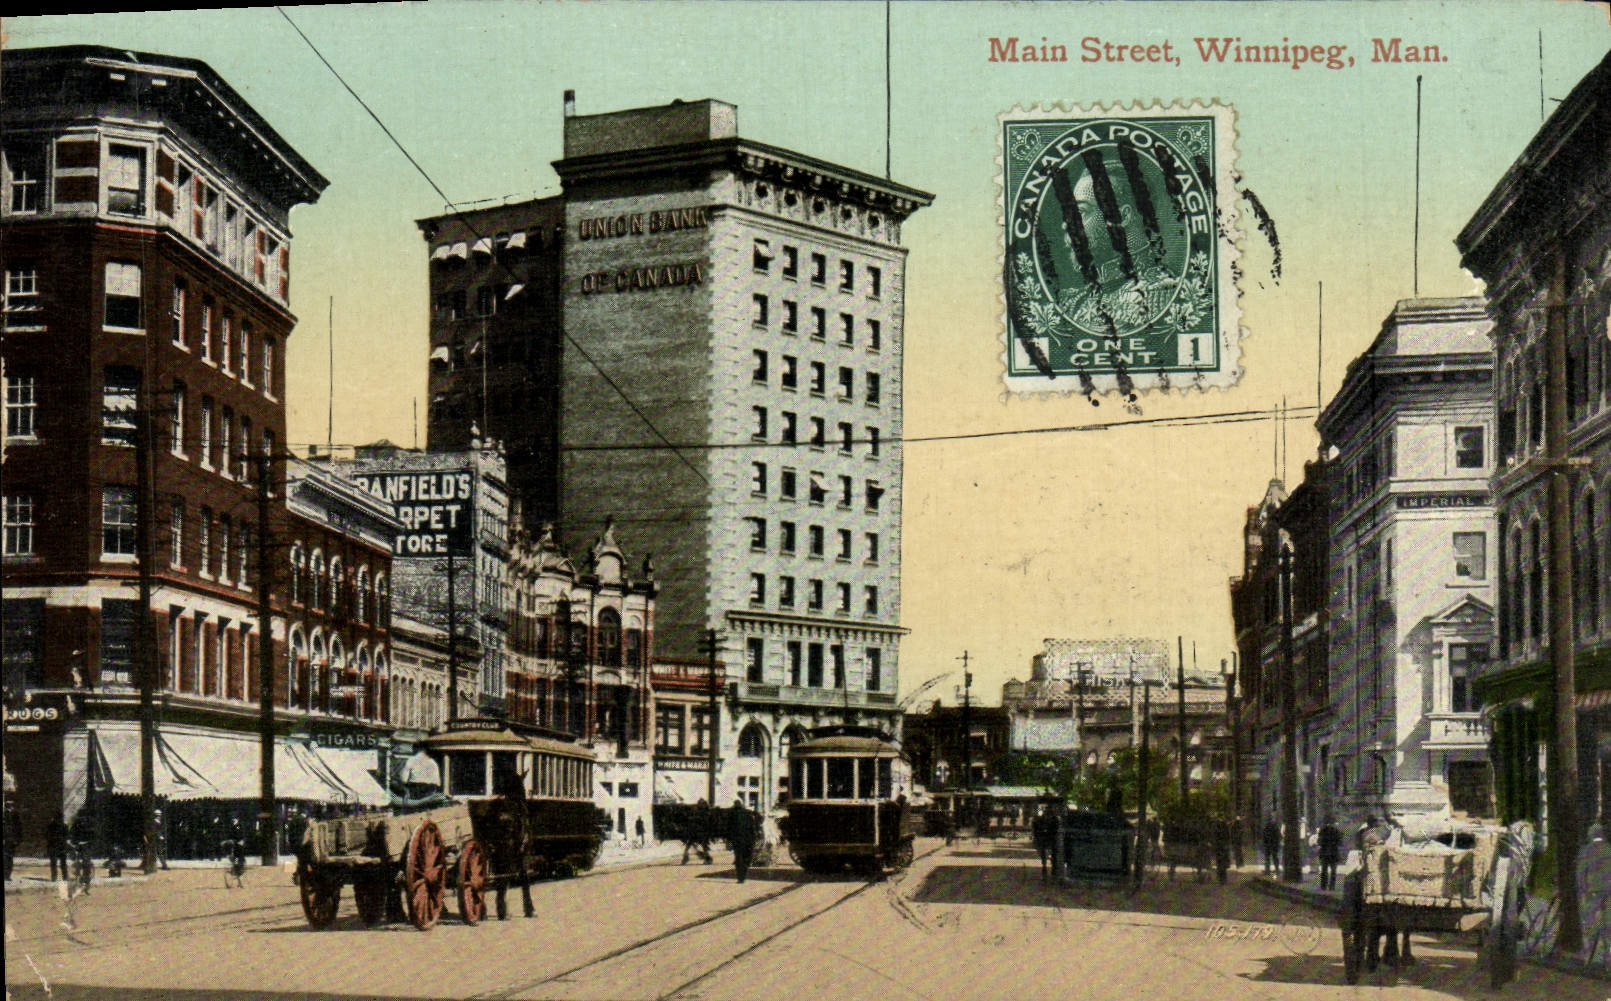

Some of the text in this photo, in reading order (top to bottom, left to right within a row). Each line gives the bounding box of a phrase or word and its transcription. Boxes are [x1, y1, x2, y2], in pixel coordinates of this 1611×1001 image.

[1015, 128, 1101, 238] CANADA
[579, 205, 708, 240] UNION BANK
[615, 262, 703, 292] CANADA
[1076, 337, 1146, 352] ONE
[1190, 337, 1201, 362] 1
[1069, 351, 1157, 366] CENT
[1403, 496, 1474, 508] IMPERIAL
[387, 504, 461, 530] RPET
[317, 732, 377, 746] CIGARS
